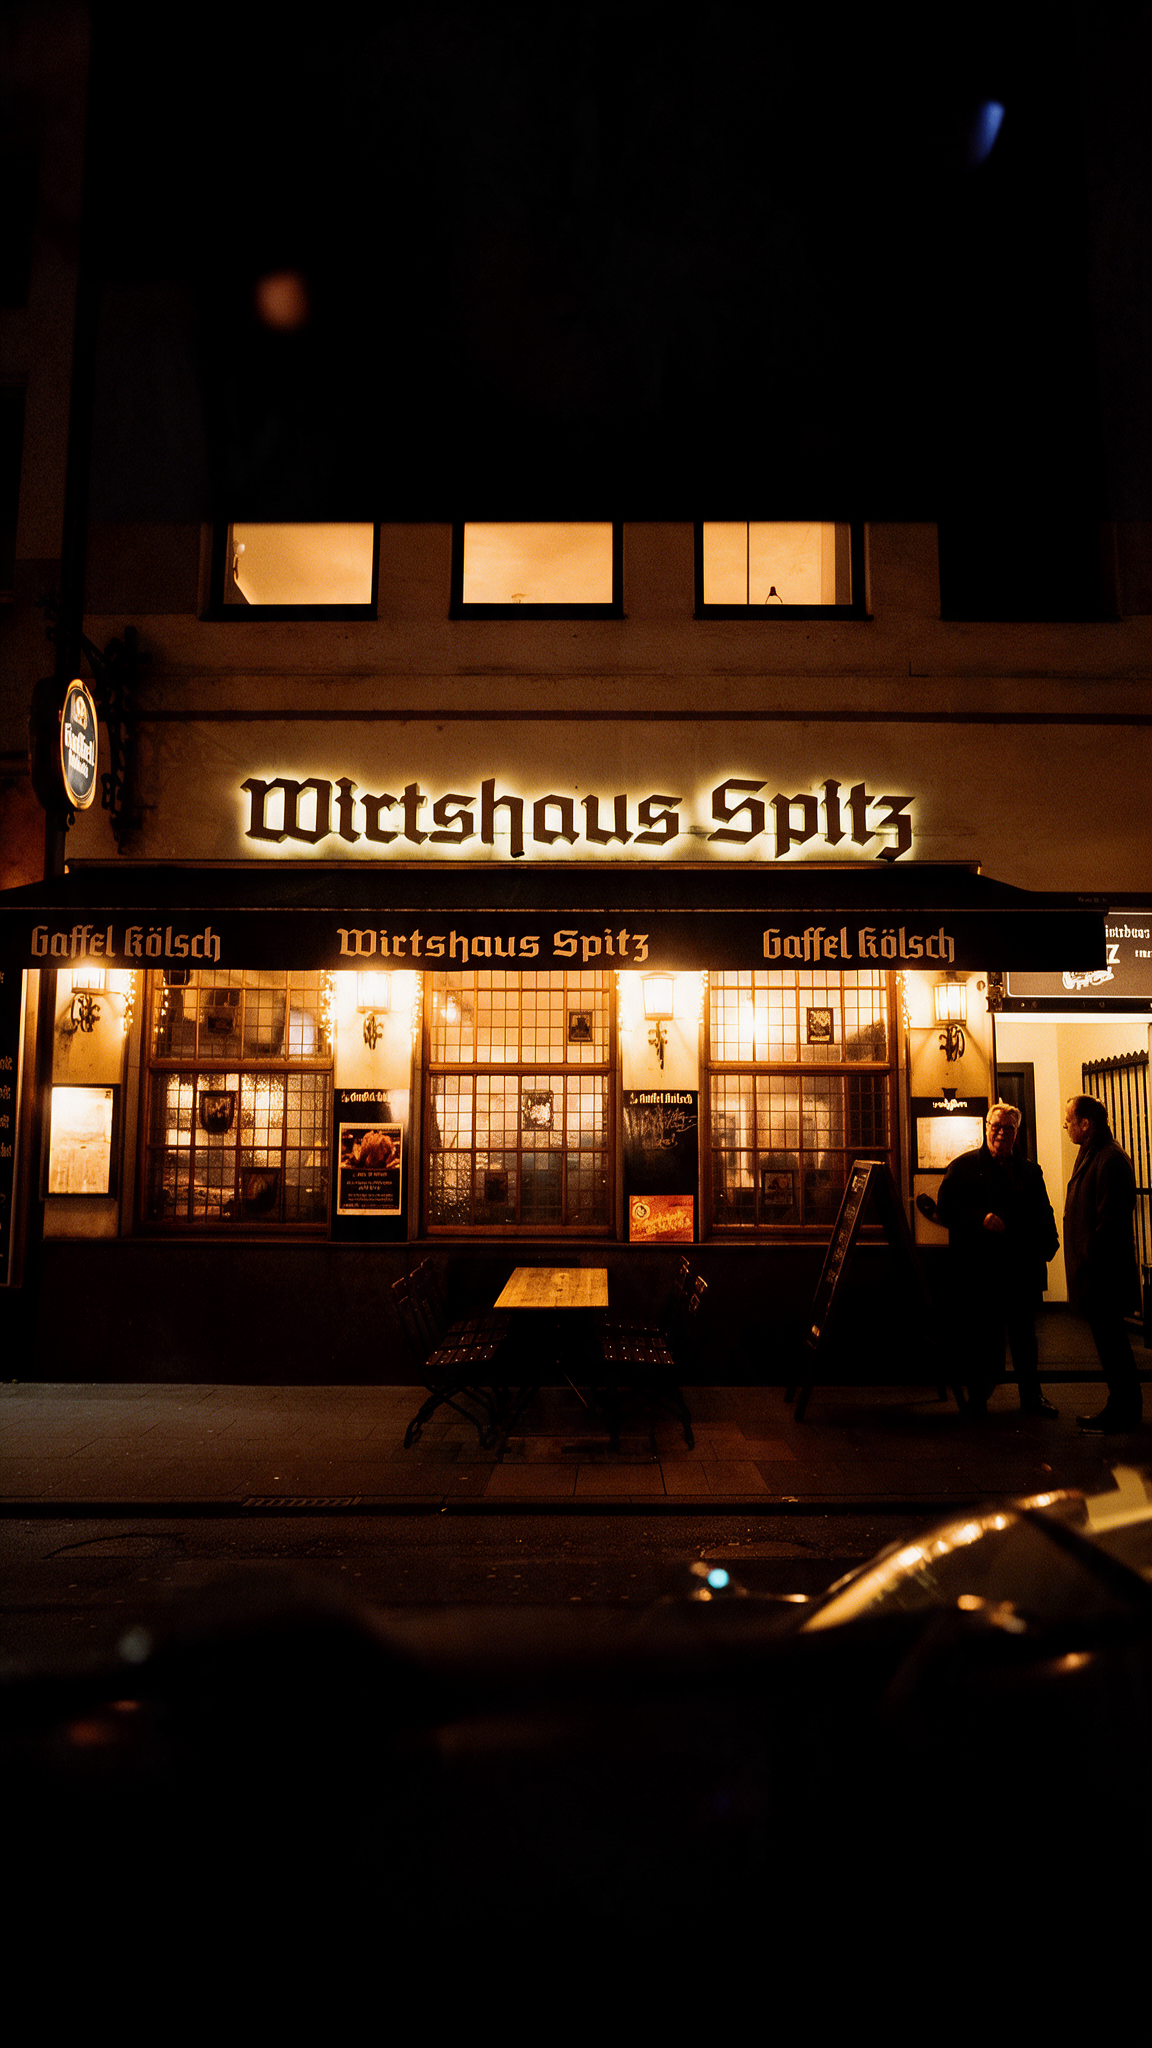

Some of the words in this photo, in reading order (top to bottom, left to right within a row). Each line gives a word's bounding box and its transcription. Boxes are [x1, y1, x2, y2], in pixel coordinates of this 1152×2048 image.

[240, 777, 683, 858] Wirtshaus
[707, 778, 915, 861] Spitz
[31, 925, 116, 959] Gaffel
[124, 926, 221, 963] Kölsch
[336, 928, 541, 963] Wirtshaus
[552, 928, 650, 963] Spitz
[763, 927, 853, 963] Gaffel
[858, 926, 955, 964] Kölsch
